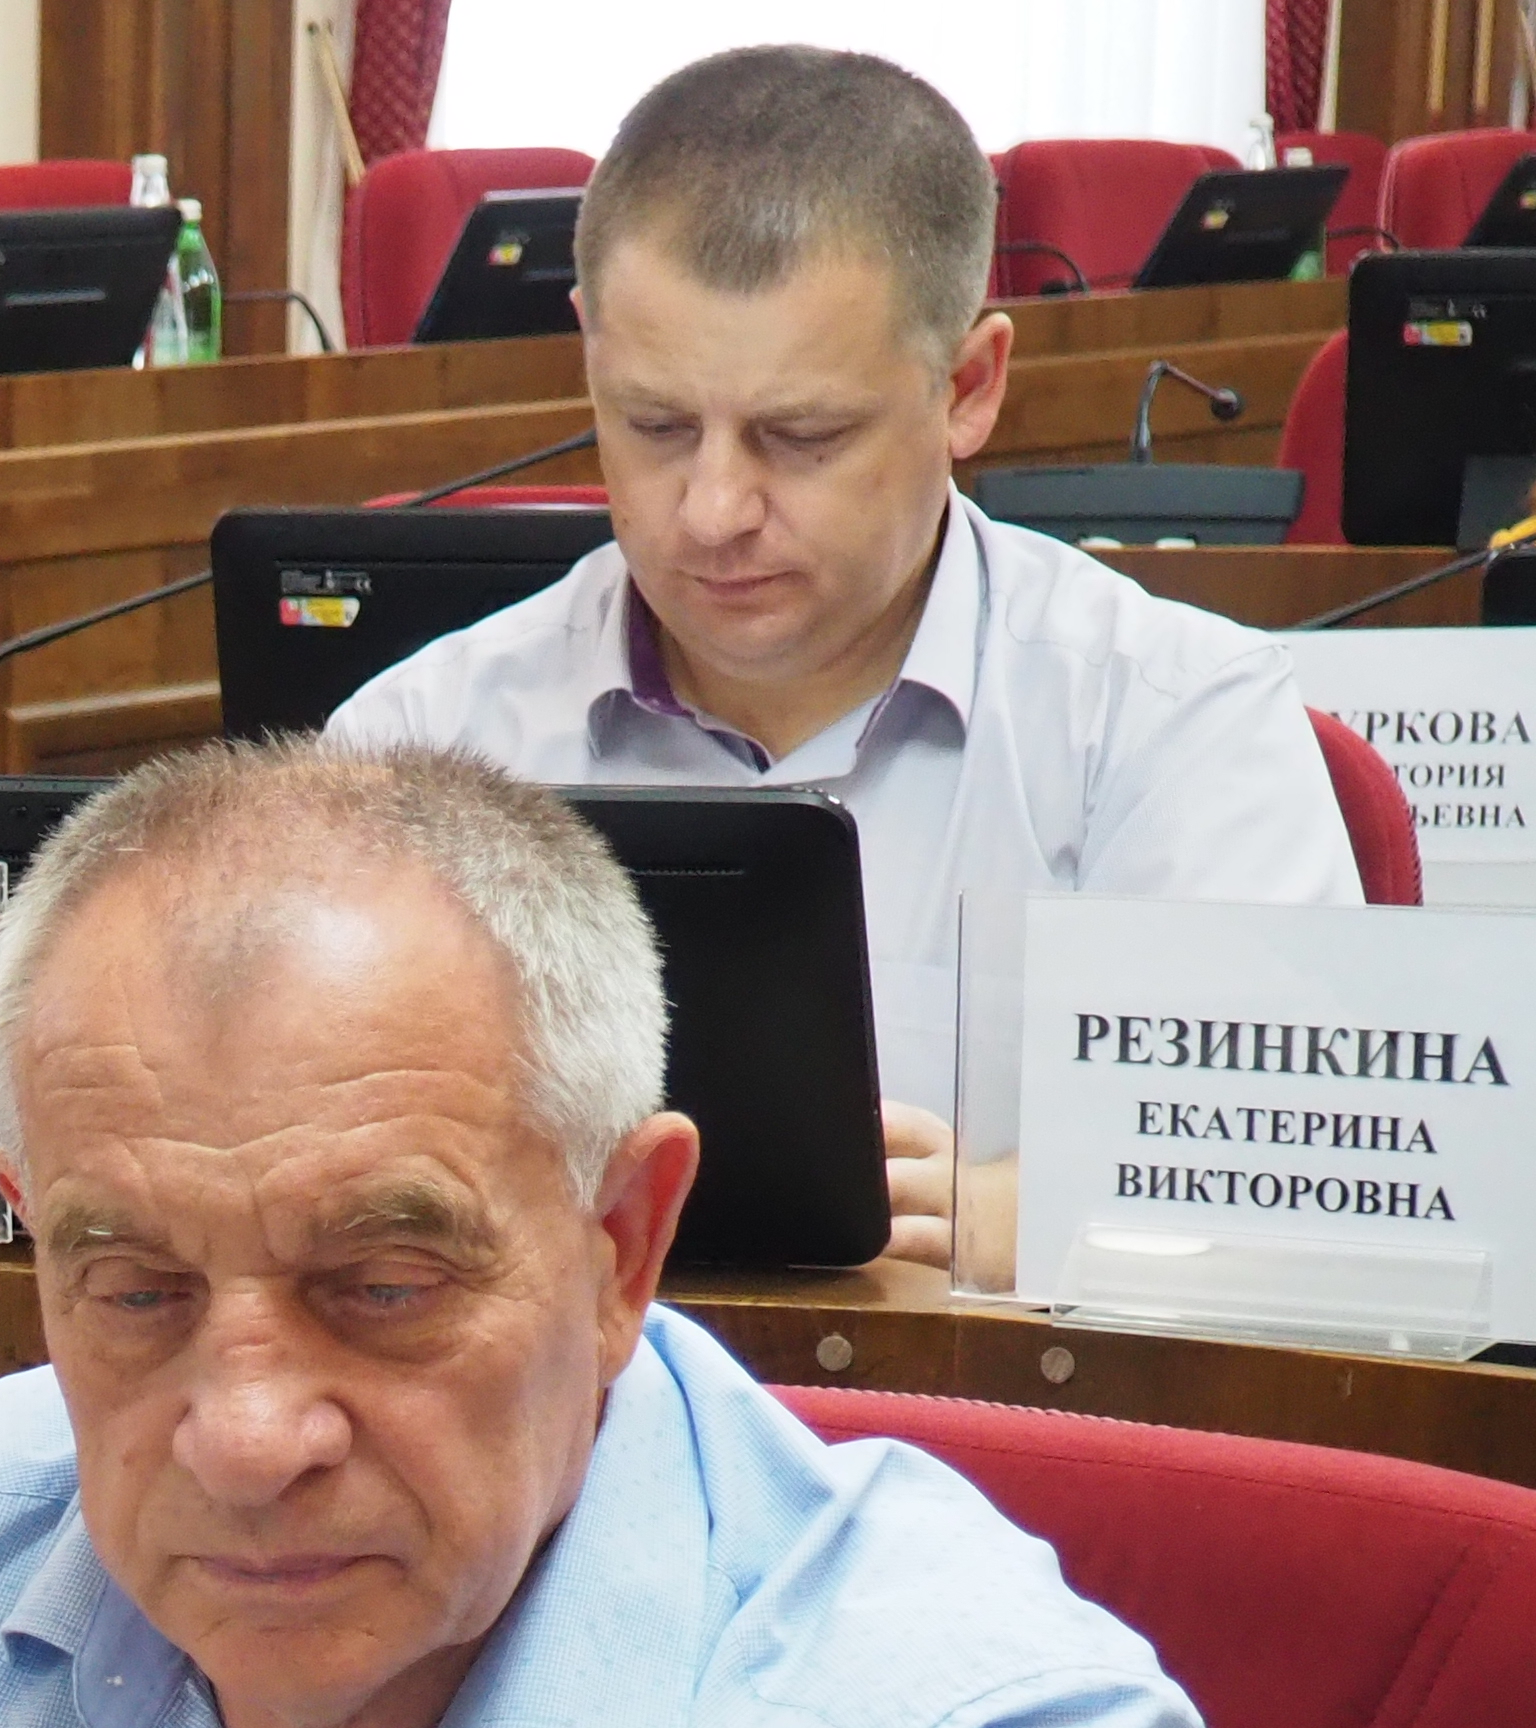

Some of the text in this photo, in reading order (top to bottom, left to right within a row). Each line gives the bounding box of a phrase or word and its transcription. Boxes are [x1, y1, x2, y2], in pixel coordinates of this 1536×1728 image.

[1074, 1013, 1510, 1086] РЕЗИНКИНА
[1136, 1101, 1438, 1154] ЕКАТЕРИНА
[1115, 1163, 1456, 1221] ВИКТОРОВНА
